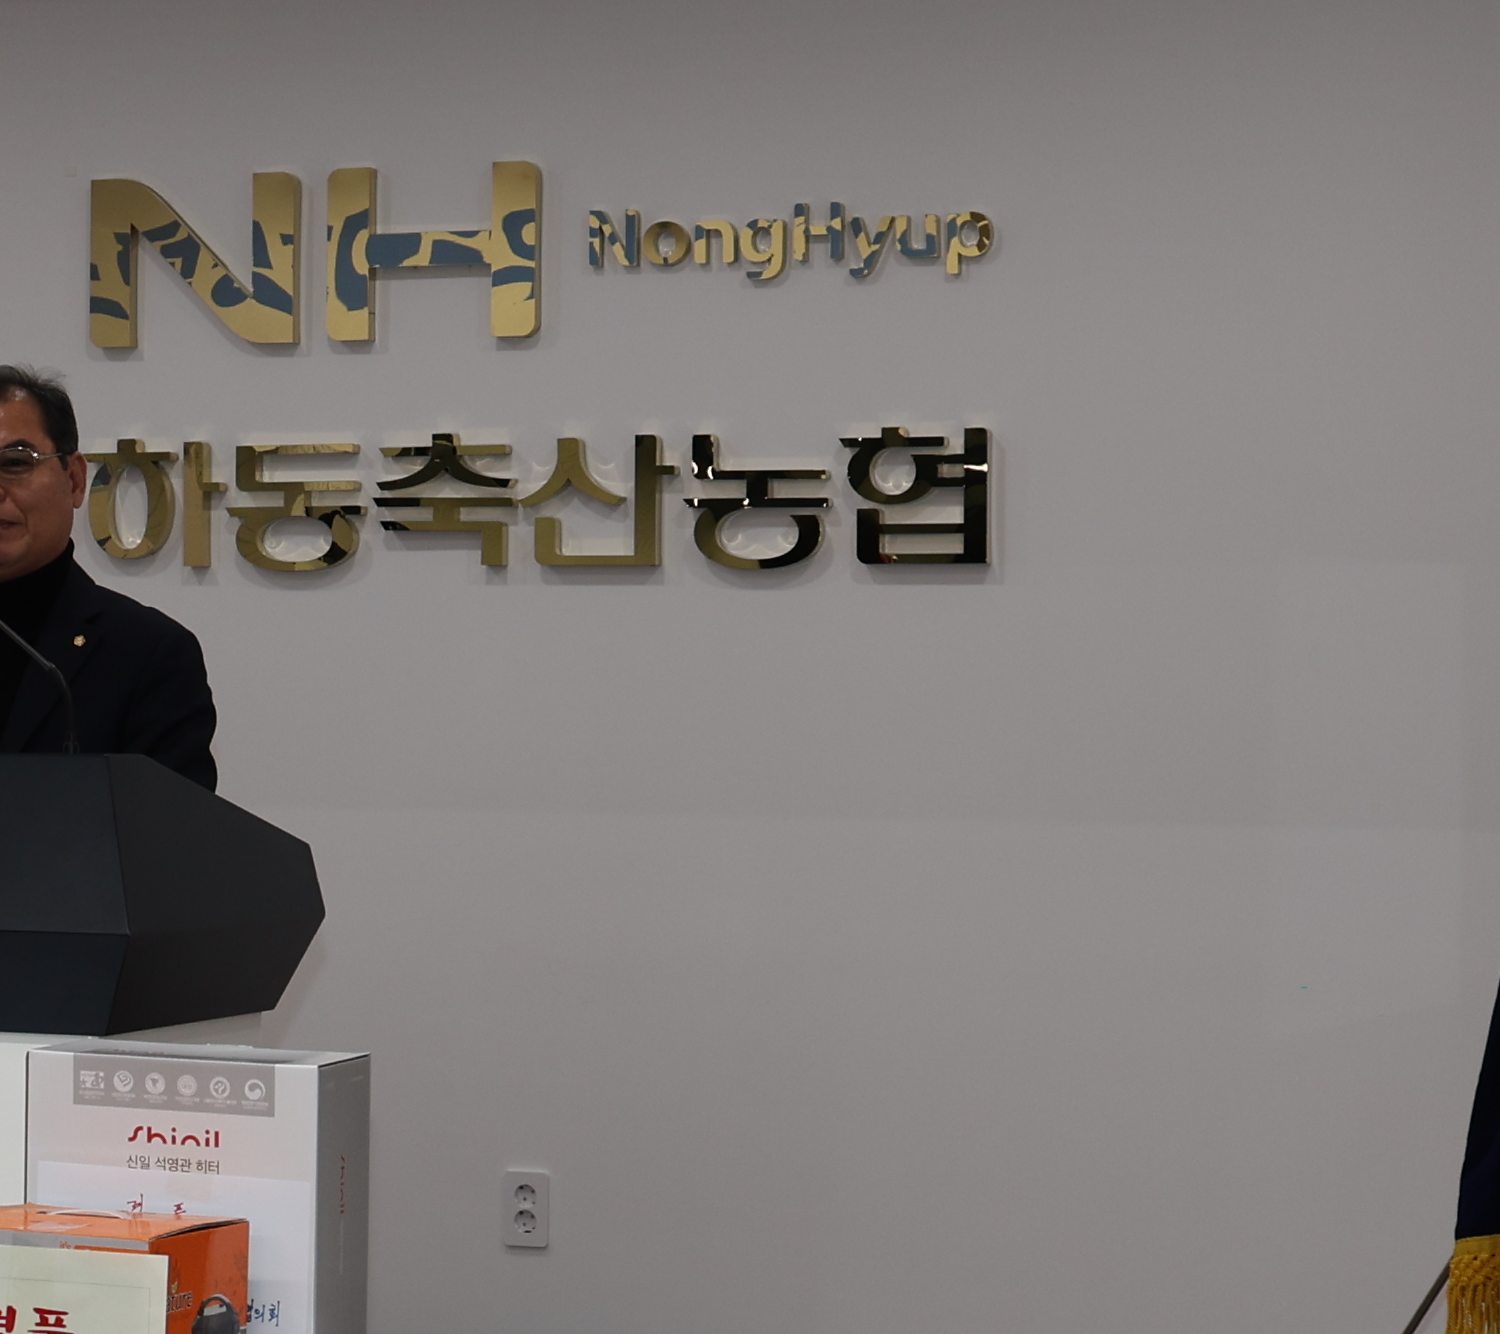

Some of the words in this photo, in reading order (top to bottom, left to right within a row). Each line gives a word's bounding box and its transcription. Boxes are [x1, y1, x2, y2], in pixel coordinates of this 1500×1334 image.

[88, 161, 543, 350] NH
[588, 201, 996, 282] NongHyup
[80, 427, 989, 570] 하동축산농협
[127, 1155, 150, 1169] 신일
[154, 1157, 192, 1173] 석영관
[196, 1159, 220, 1175] 히터
